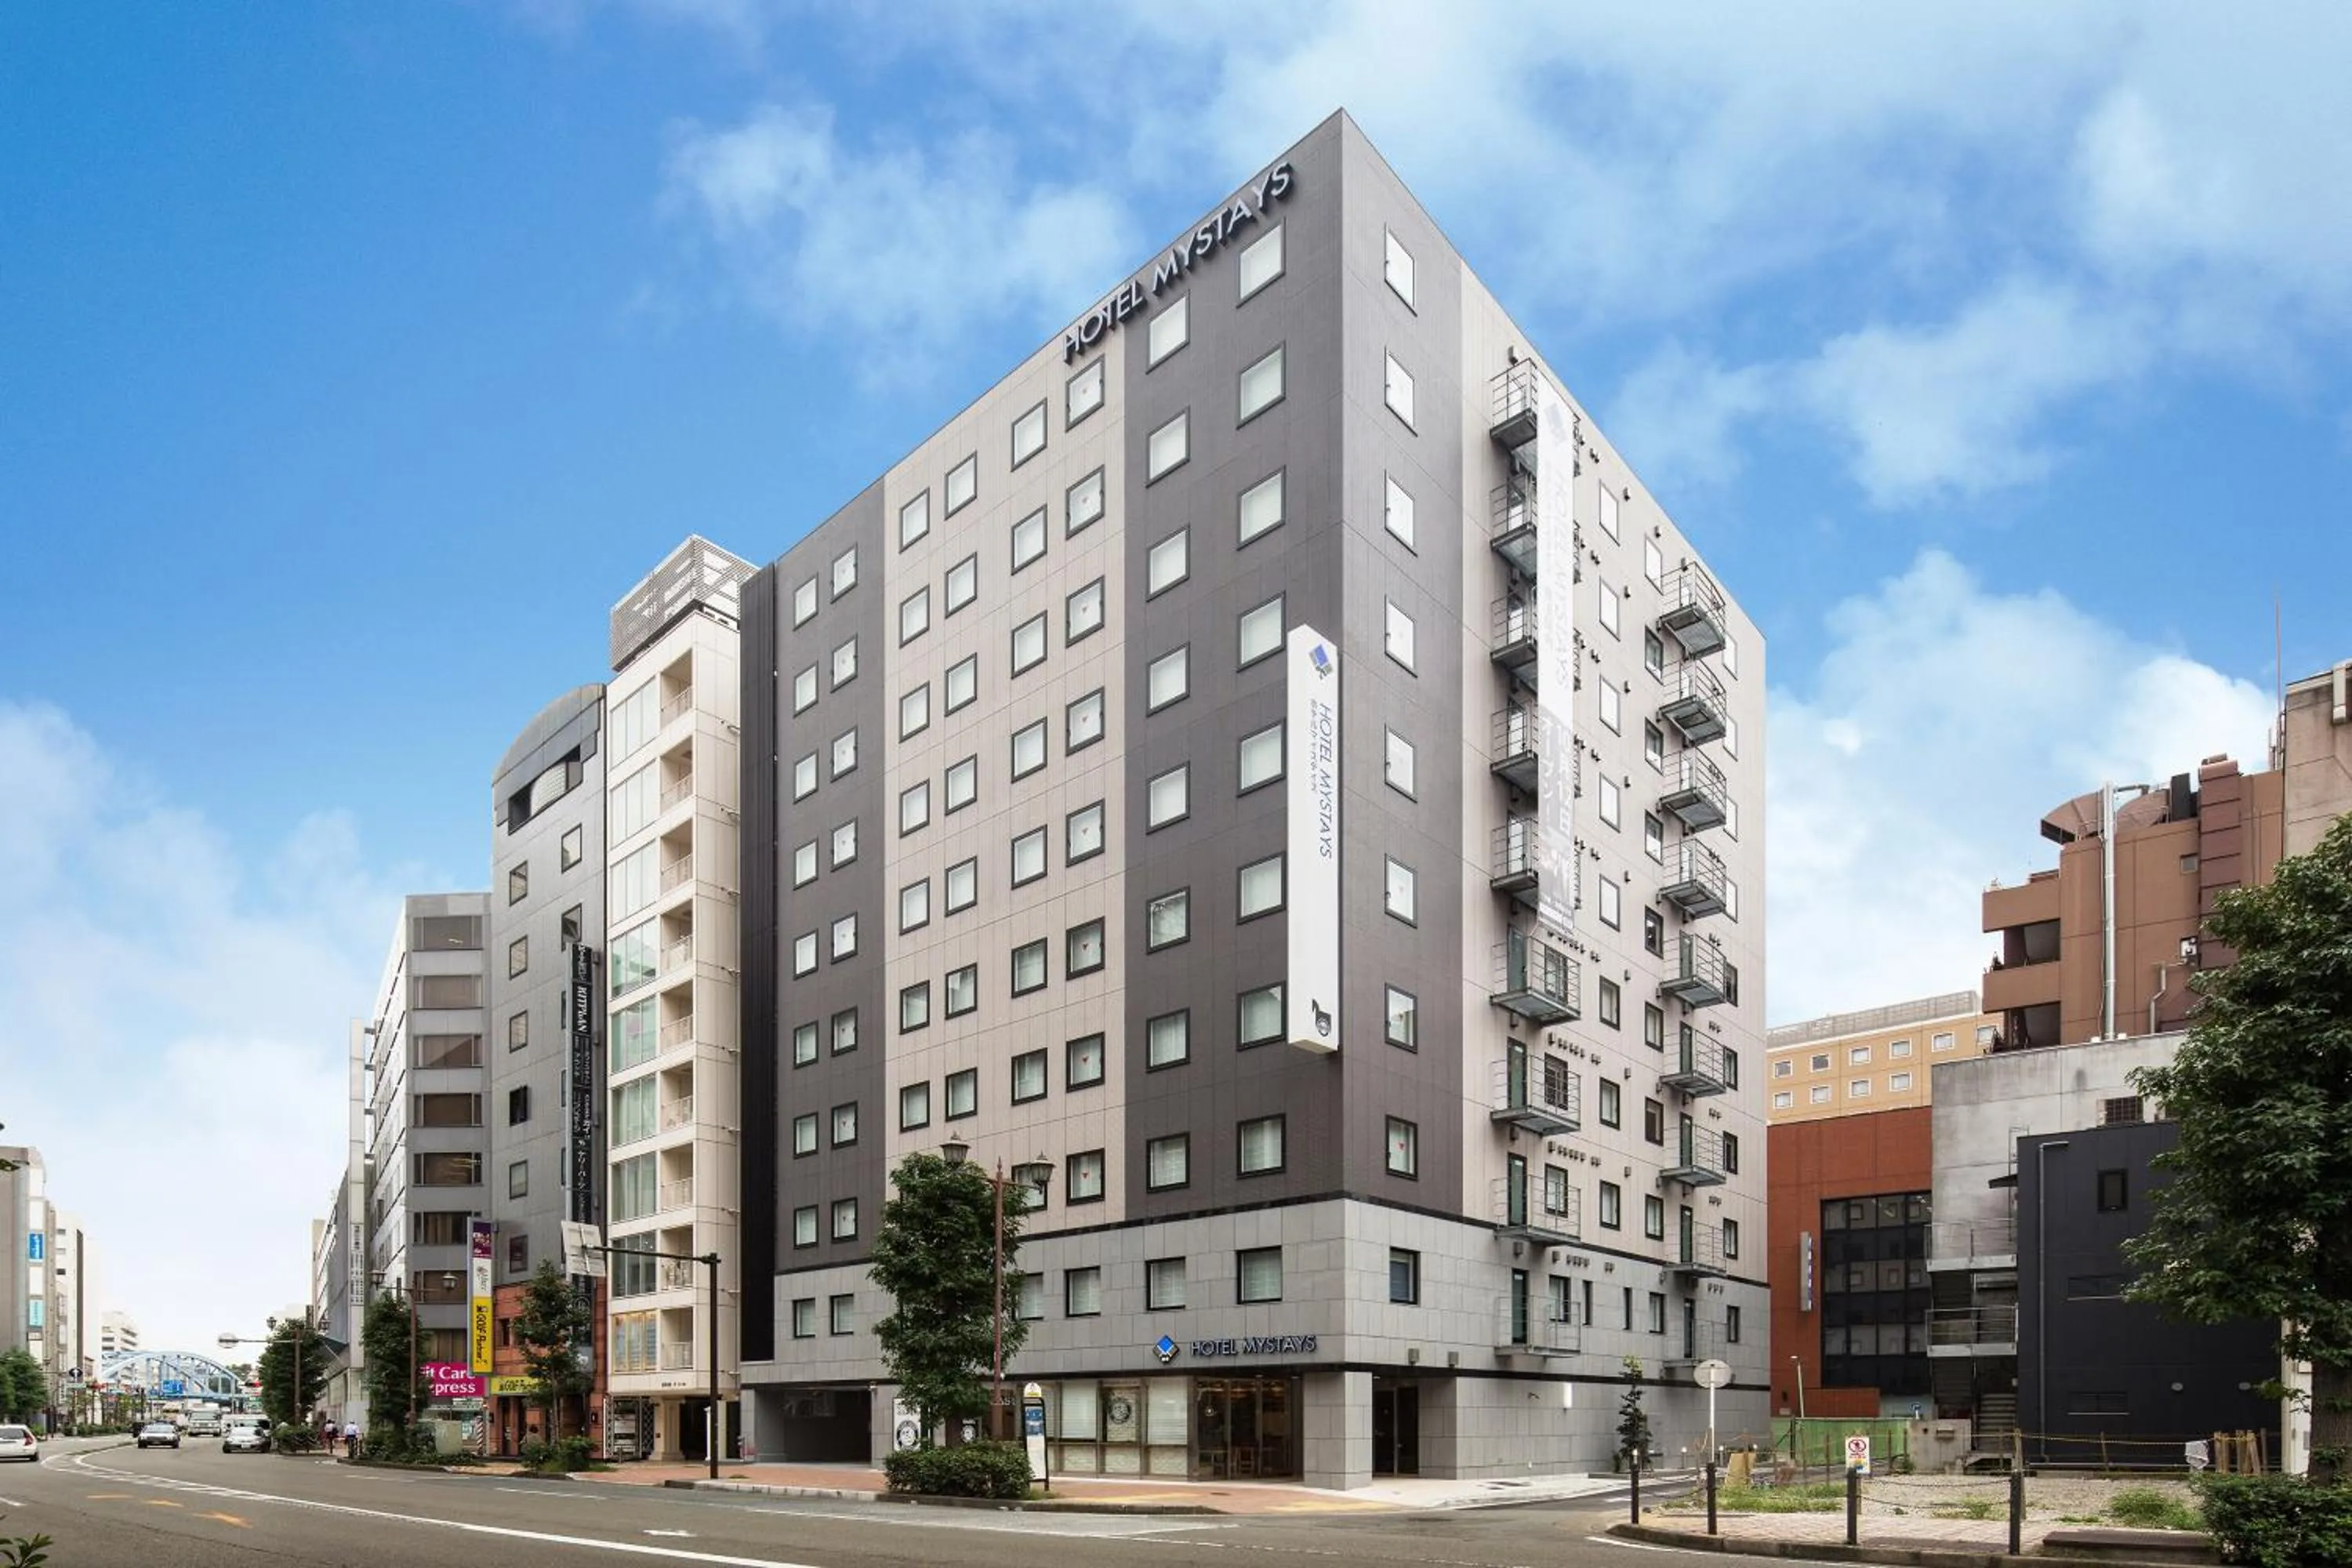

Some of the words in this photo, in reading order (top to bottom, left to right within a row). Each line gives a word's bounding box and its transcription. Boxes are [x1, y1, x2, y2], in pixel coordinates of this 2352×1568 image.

[1064, 278, 1147, 364] HOTEL
[1152, 161, 1294, 295] MYSTAYS
[1319, 702, 1332, 763] HOTEL
[1319, 768, 1332, 859] MYSTAYS
[1191, 1340, 1237, 1356] HOTEL
[1243, 1335, 1317, 1354] MYSTAYS
[429, 1382, 476, 1396] press
